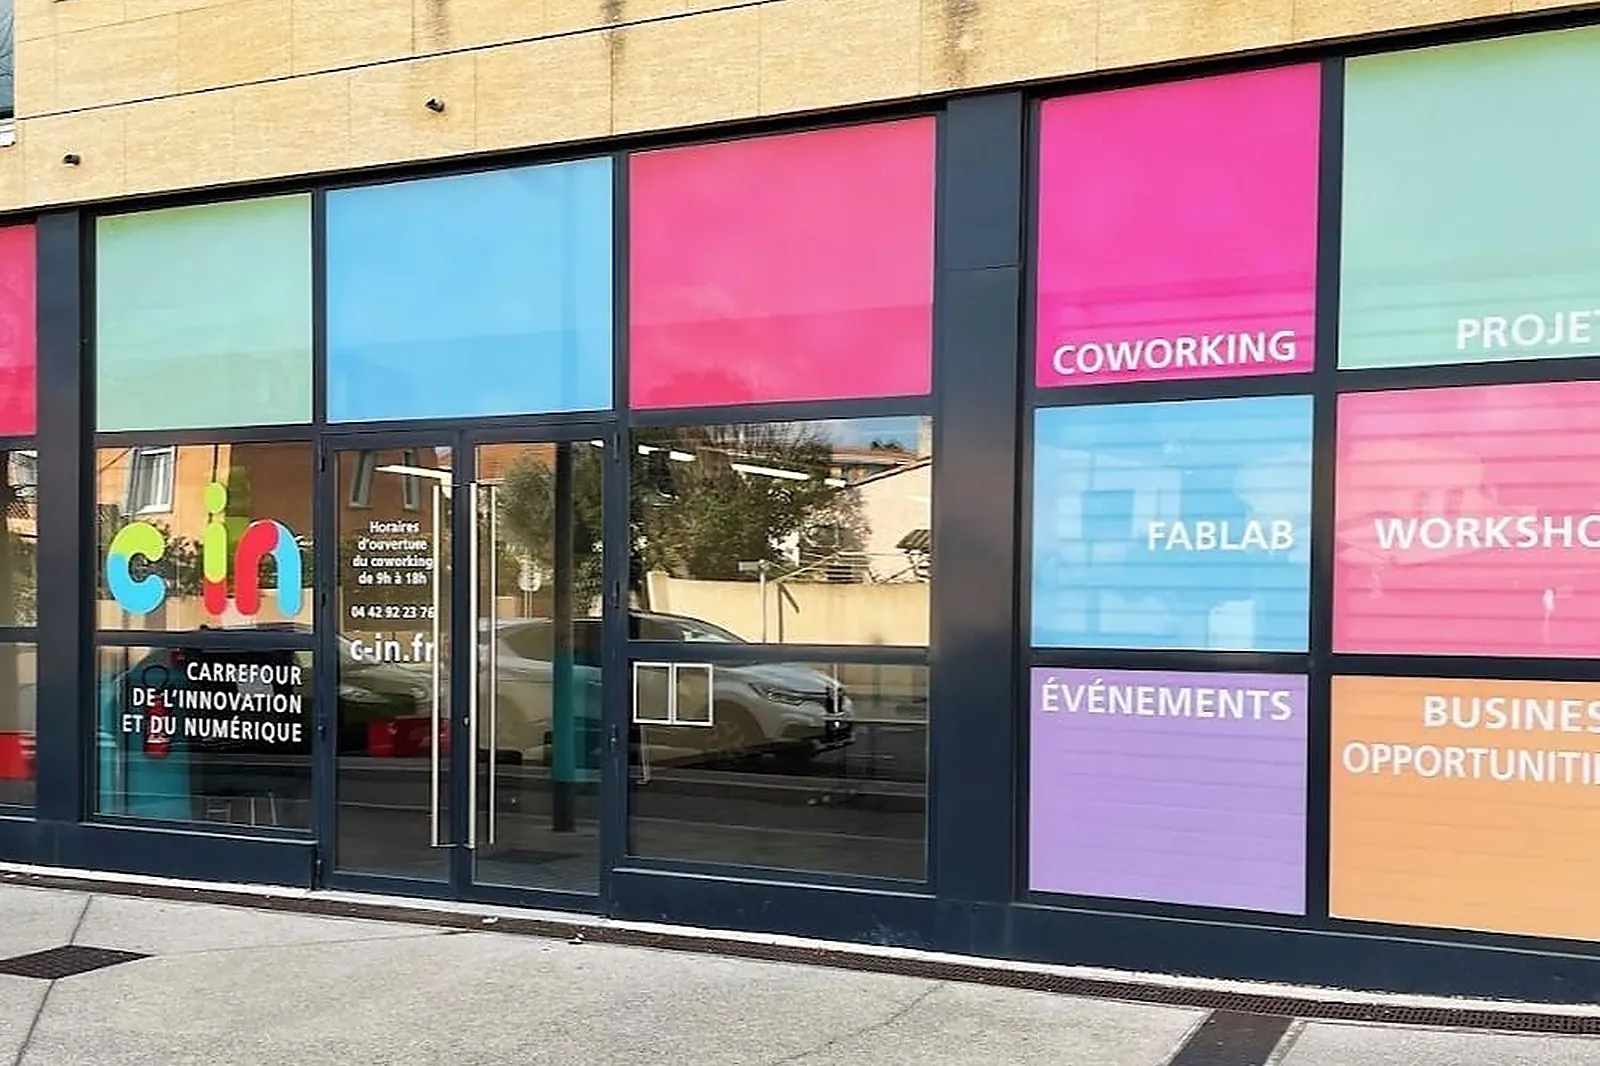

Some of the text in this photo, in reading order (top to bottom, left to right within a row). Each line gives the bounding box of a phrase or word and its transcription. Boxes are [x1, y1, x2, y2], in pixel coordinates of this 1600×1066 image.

[1052, 330, 1296, 376] COWORKING
[369, 521, 420, 533] Horaires
[1147, 520, 1294, 552] FABLAB
[1374, 514, 1600, 550] WORKSHO
[107, 482, 303, 617] cin
[353, 555, 434, 570] du coworking
[358, 572, 427, 585] de 9h à 18h
[350, 606, 365, 618] 04
[367, 606, 382, 618] 42
[385, 606, 400, 618] 92
[402, 606, 417, 618] 23
[350, 633, 434, 662] c-in.fr
[186, 661, 302, 685] CARREFOUR
[132, 687, 157, 707] DE
[1041, 677, 1293, 723] ÉVÉNEMENTS
[122, 714, 302, 743] ET DU NUMÉRIQUE
